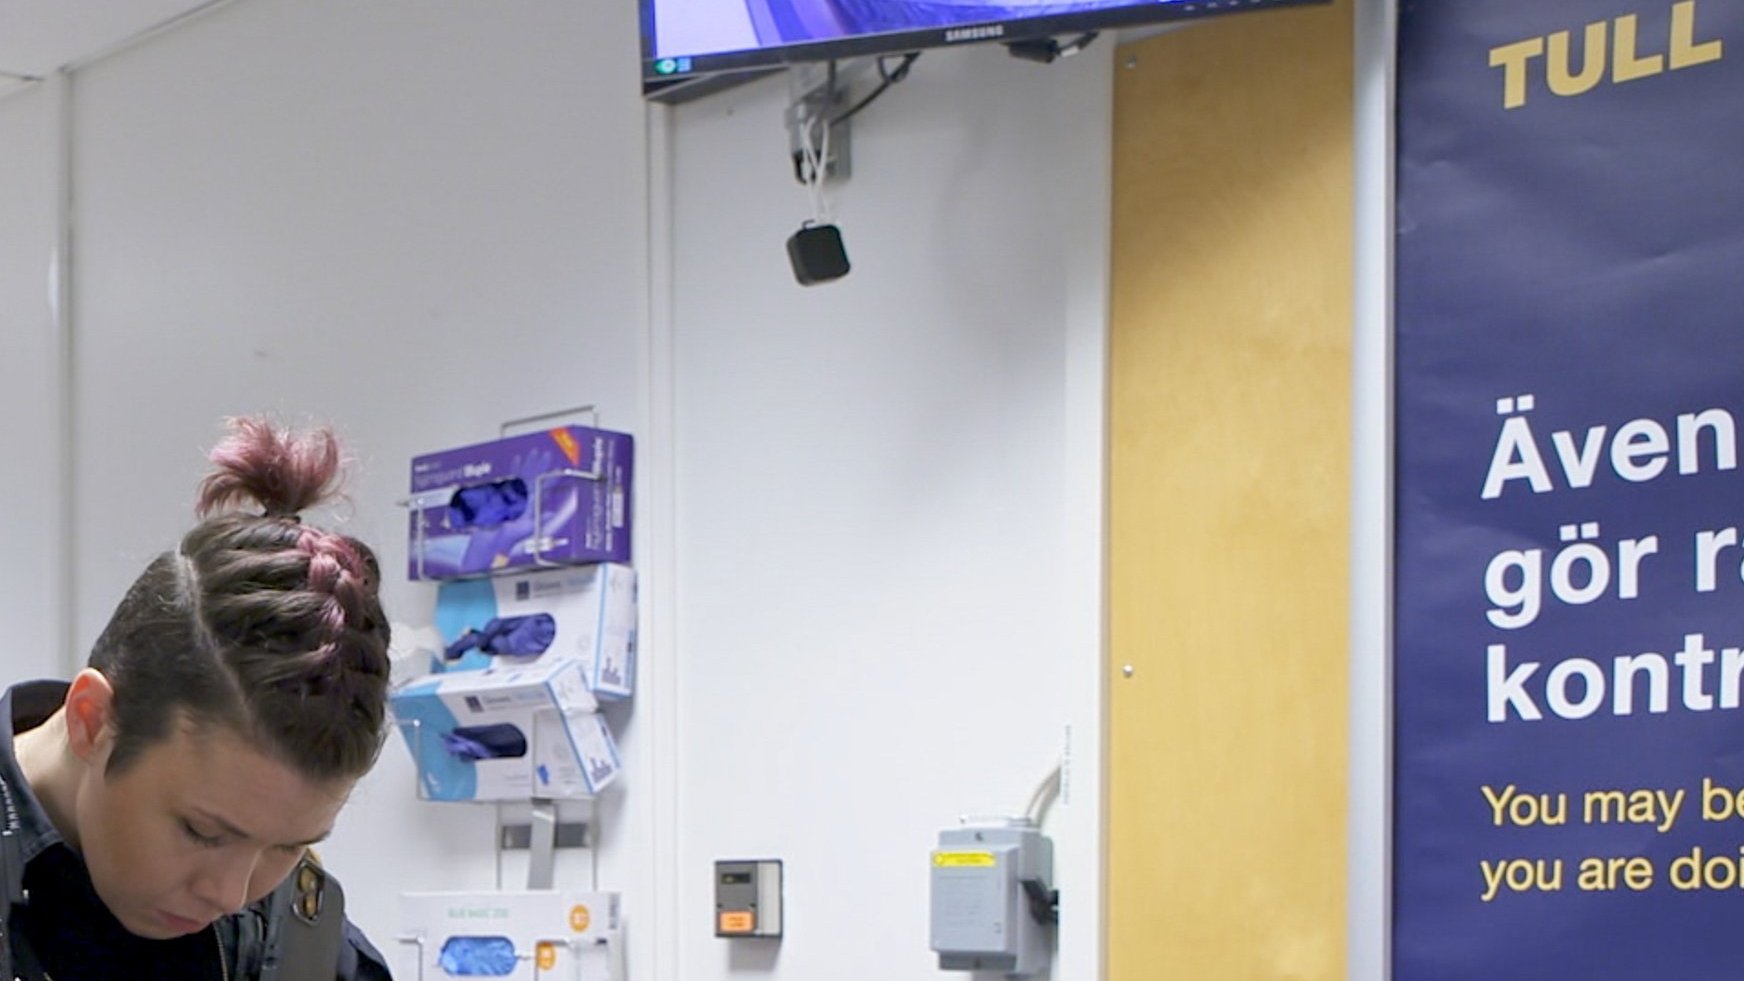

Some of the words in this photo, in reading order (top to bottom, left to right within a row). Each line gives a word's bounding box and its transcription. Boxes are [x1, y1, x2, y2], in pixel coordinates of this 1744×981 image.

[945, 24, 1004, 42] SAMSUNG
[1488, 0, 1723, 110] TULL
[1481, 394, 1737, 500] Även
[1484, 521, 1659, 630] gör
[1695, 526, 1744, 592] r
[1486, 633, 1744, 723] kontr
[1480, 784, 1567, 826] You
[1583, 788, 1685, 833] may
[1479, 858, 1563, 902] you
[1576, 856, 1654, 891] are
